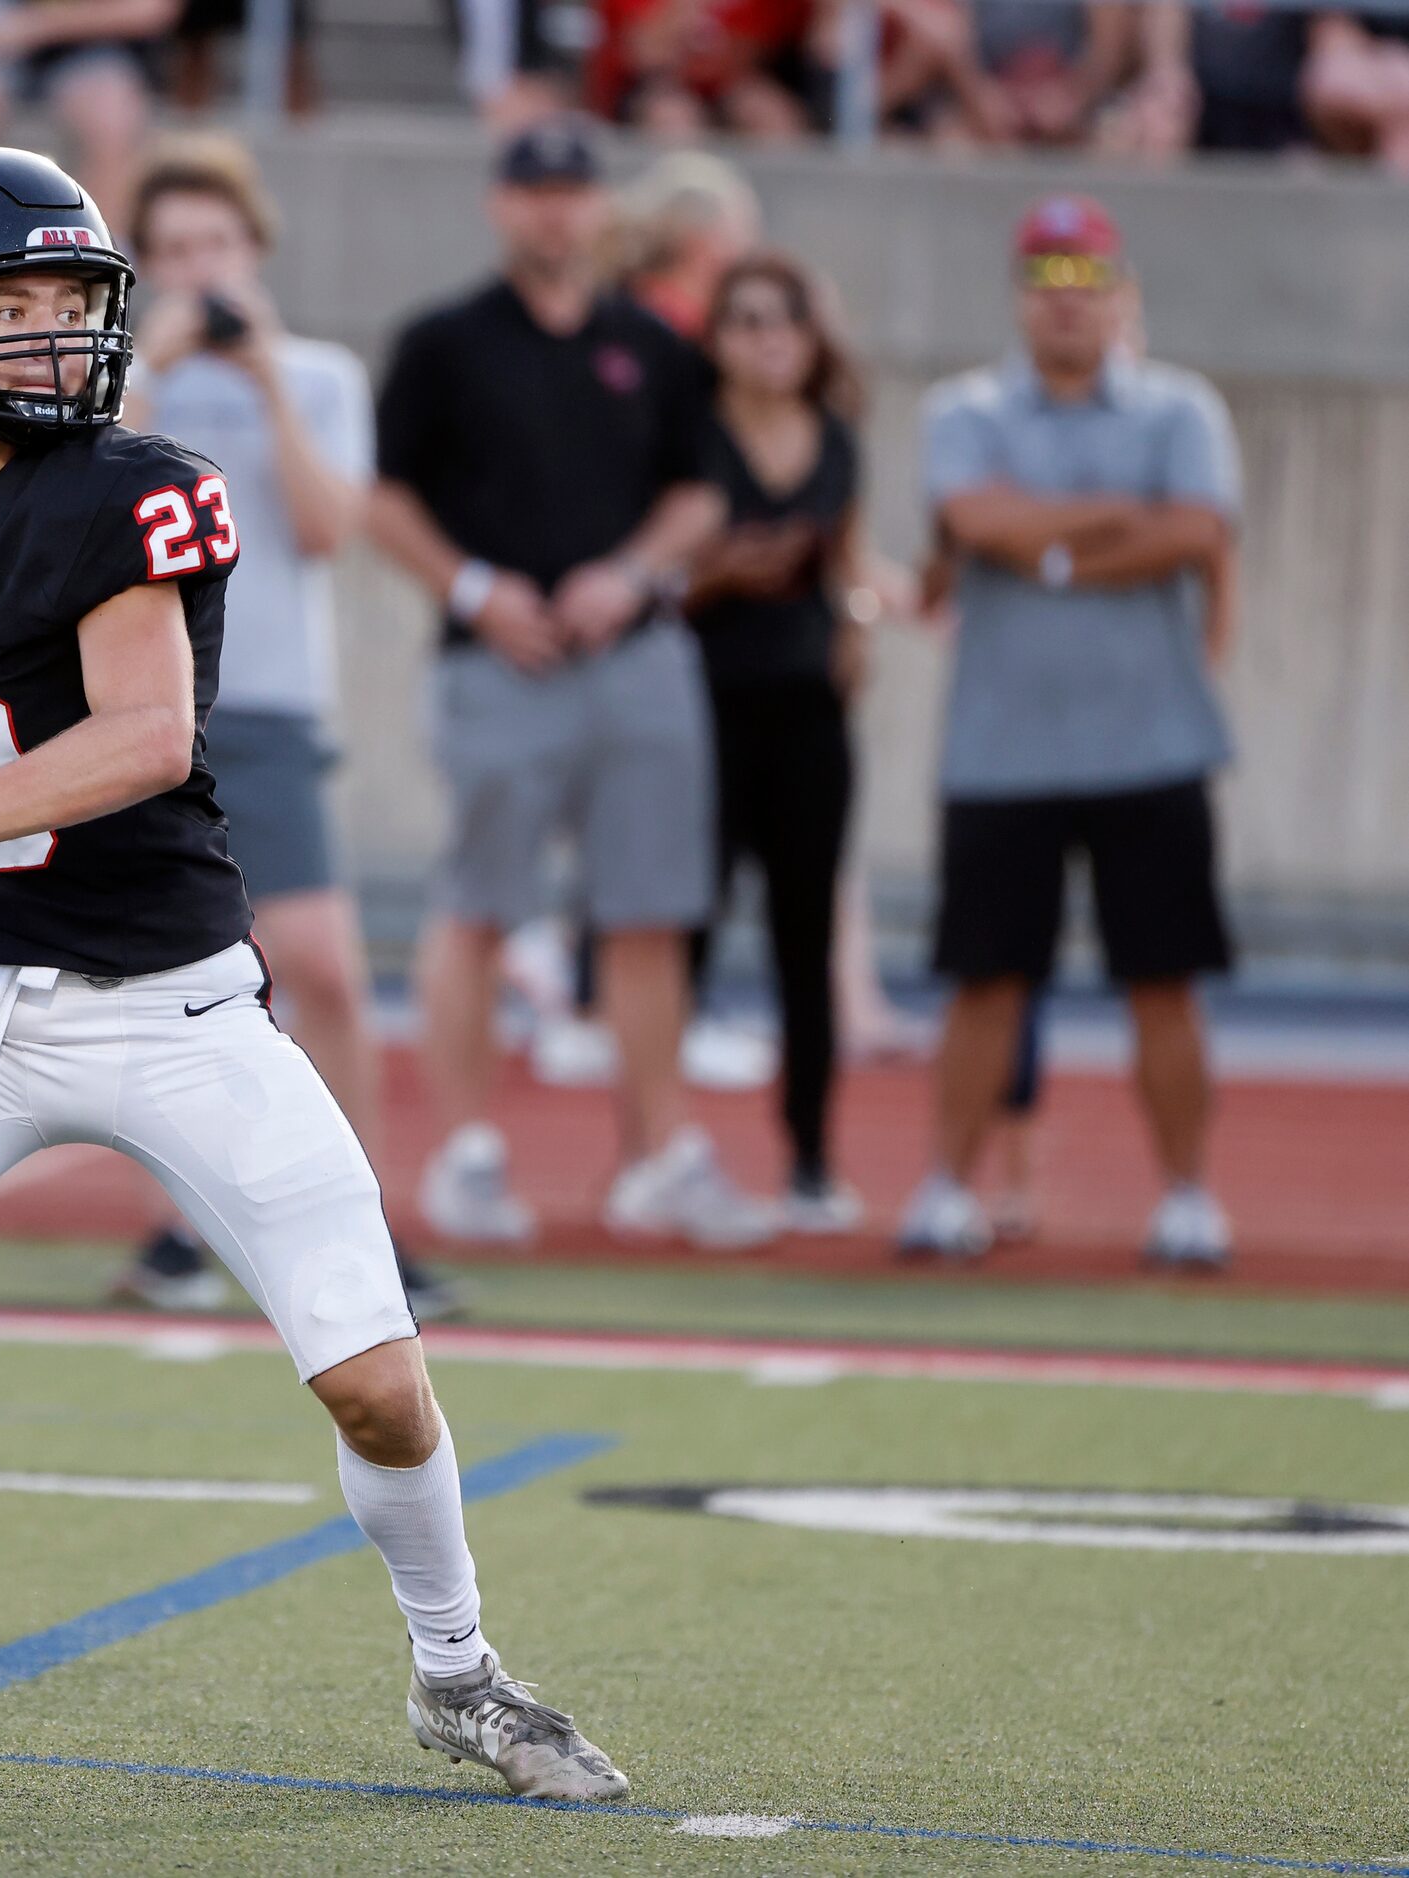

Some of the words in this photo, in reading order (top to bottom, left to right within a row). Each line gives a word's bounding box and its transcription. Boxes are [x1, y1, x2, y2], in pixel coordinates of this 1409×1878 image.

[42, 229, 73, 246] ALL
[74, 230, 91, 246] IN
[133, 474, 240, 580] 23
